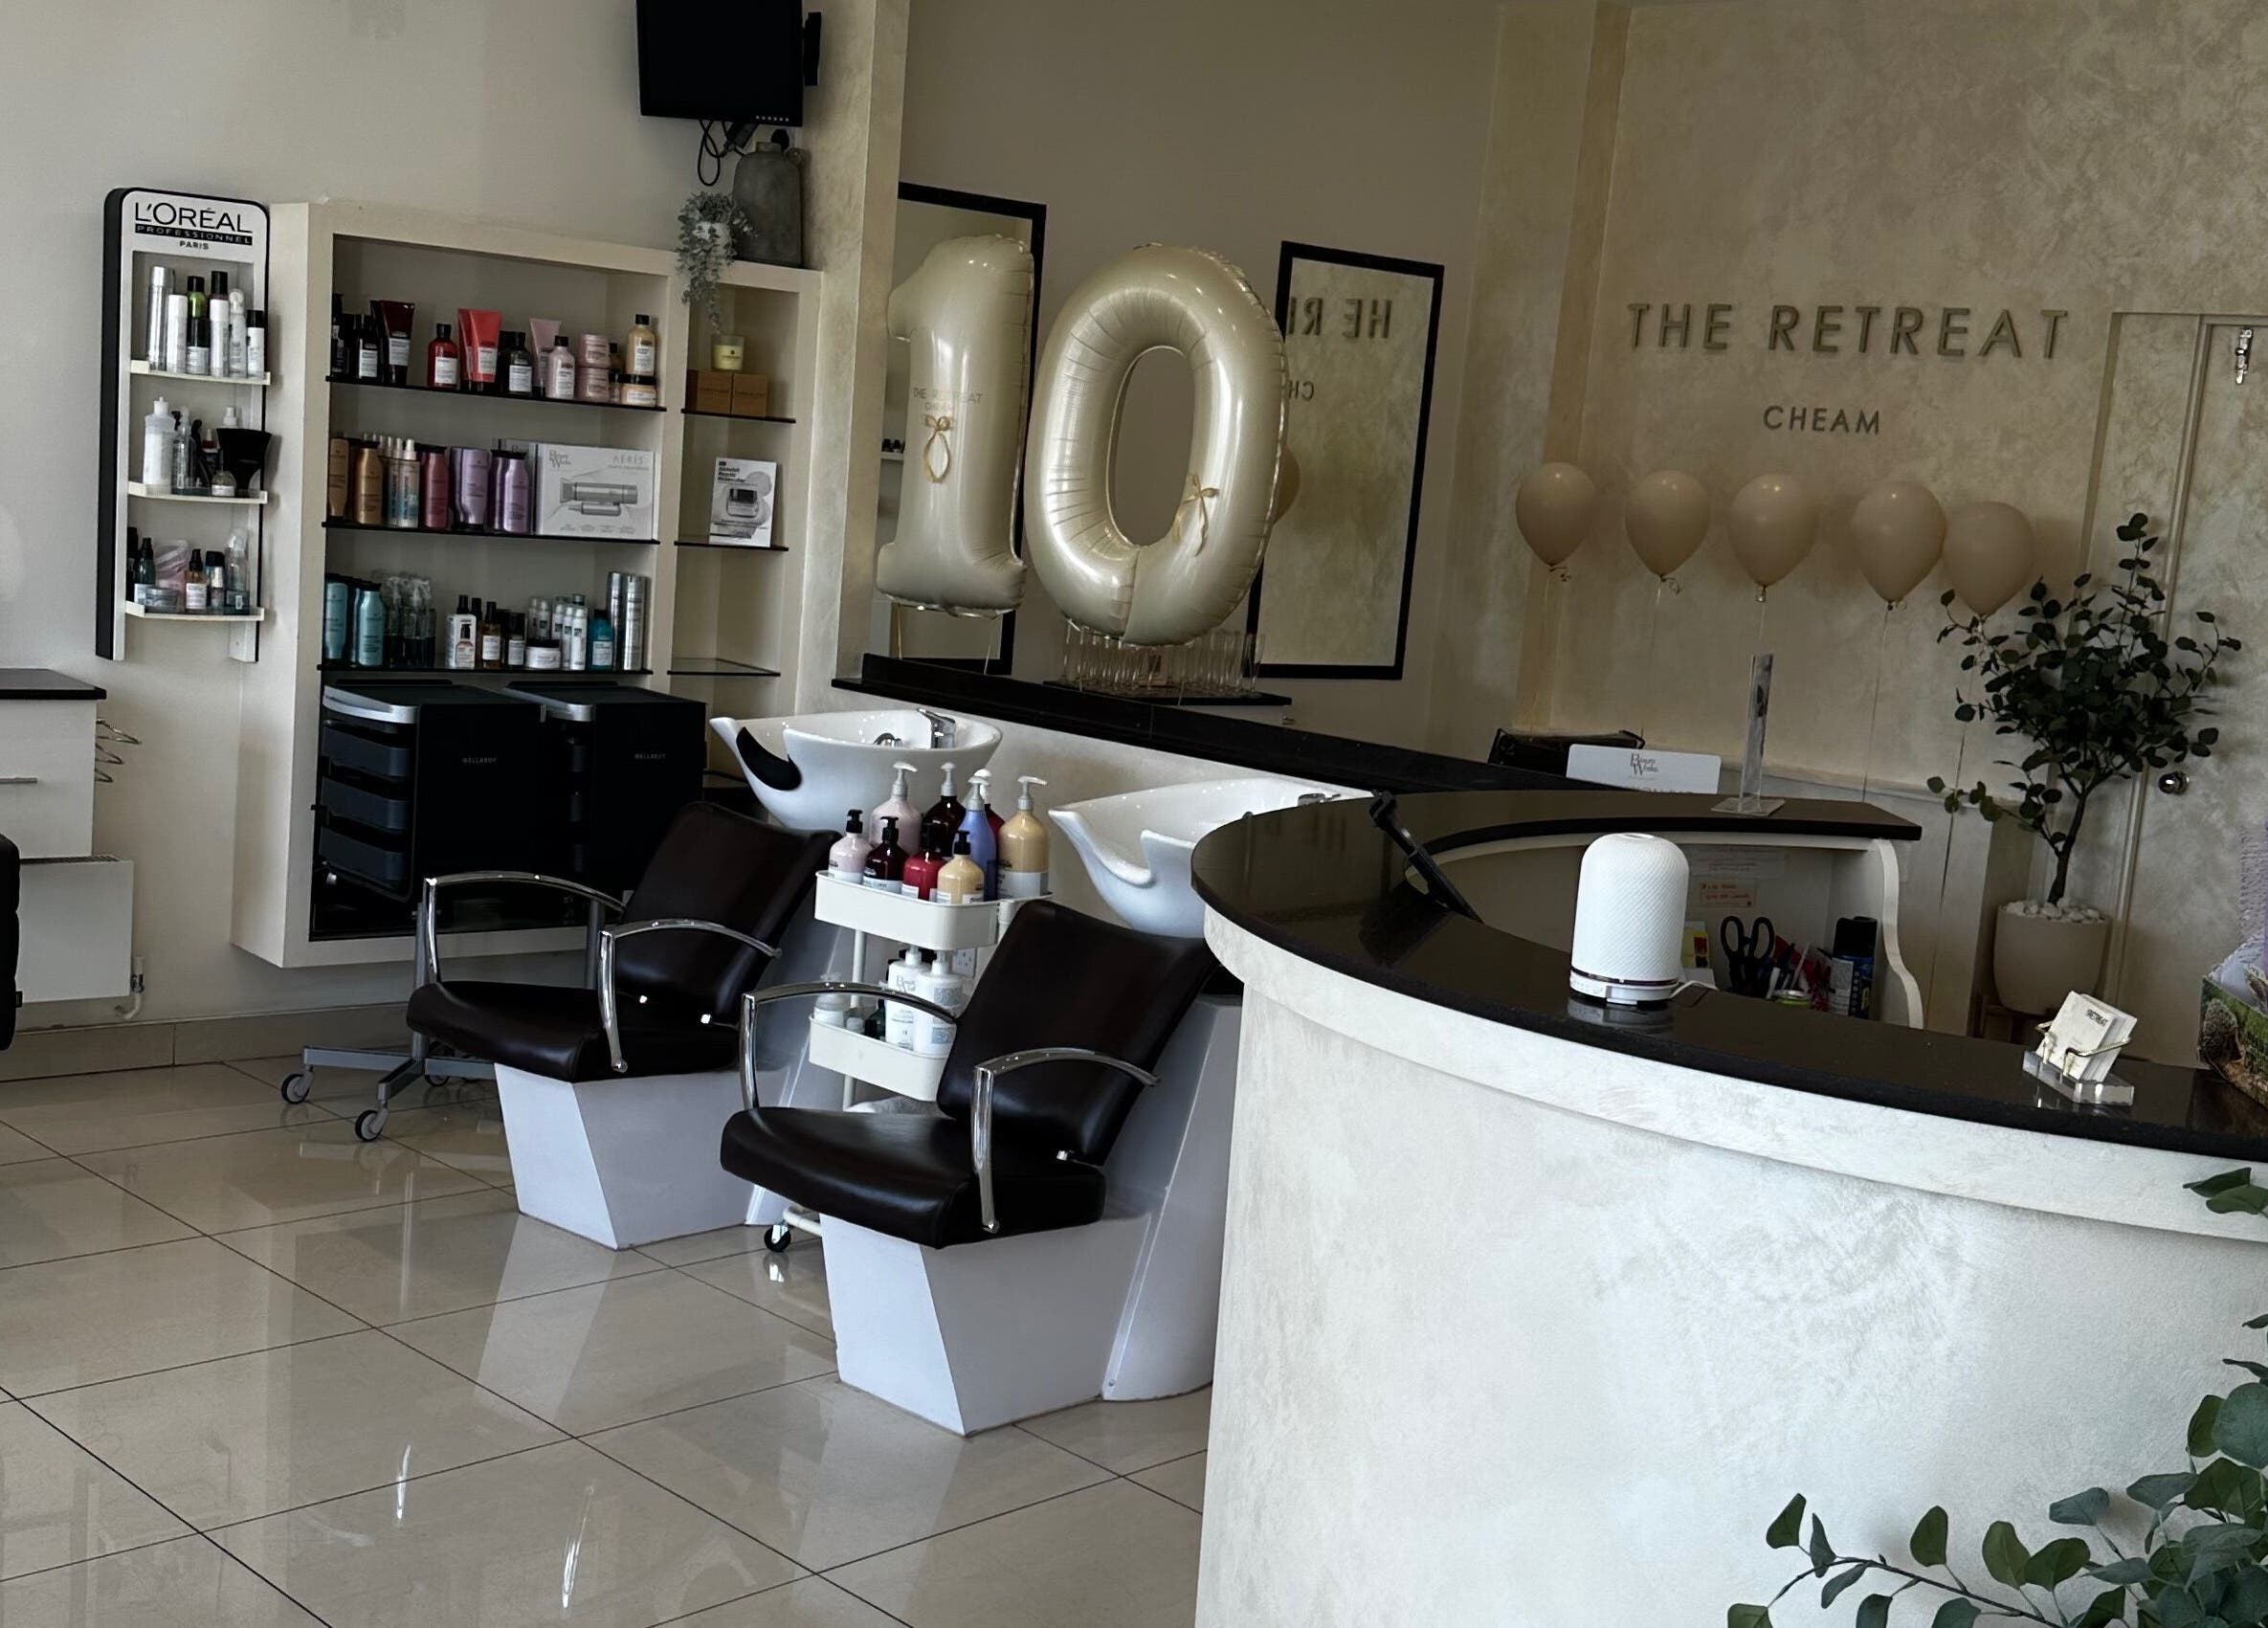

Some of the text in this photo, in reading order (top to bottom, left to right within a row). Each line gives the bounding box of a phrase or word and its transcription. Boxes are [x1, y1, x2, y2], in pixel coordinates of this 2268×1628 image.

[135, 202, 253, 234] L'ORÉAL
[137, 225, 251, 244] PROFESSIONNEL
[179, 240, 209, 250] PARIS
[1628, 303, 2068, 360] THE RETREAT
[1763, 405, 1880, 435] CHEAM
